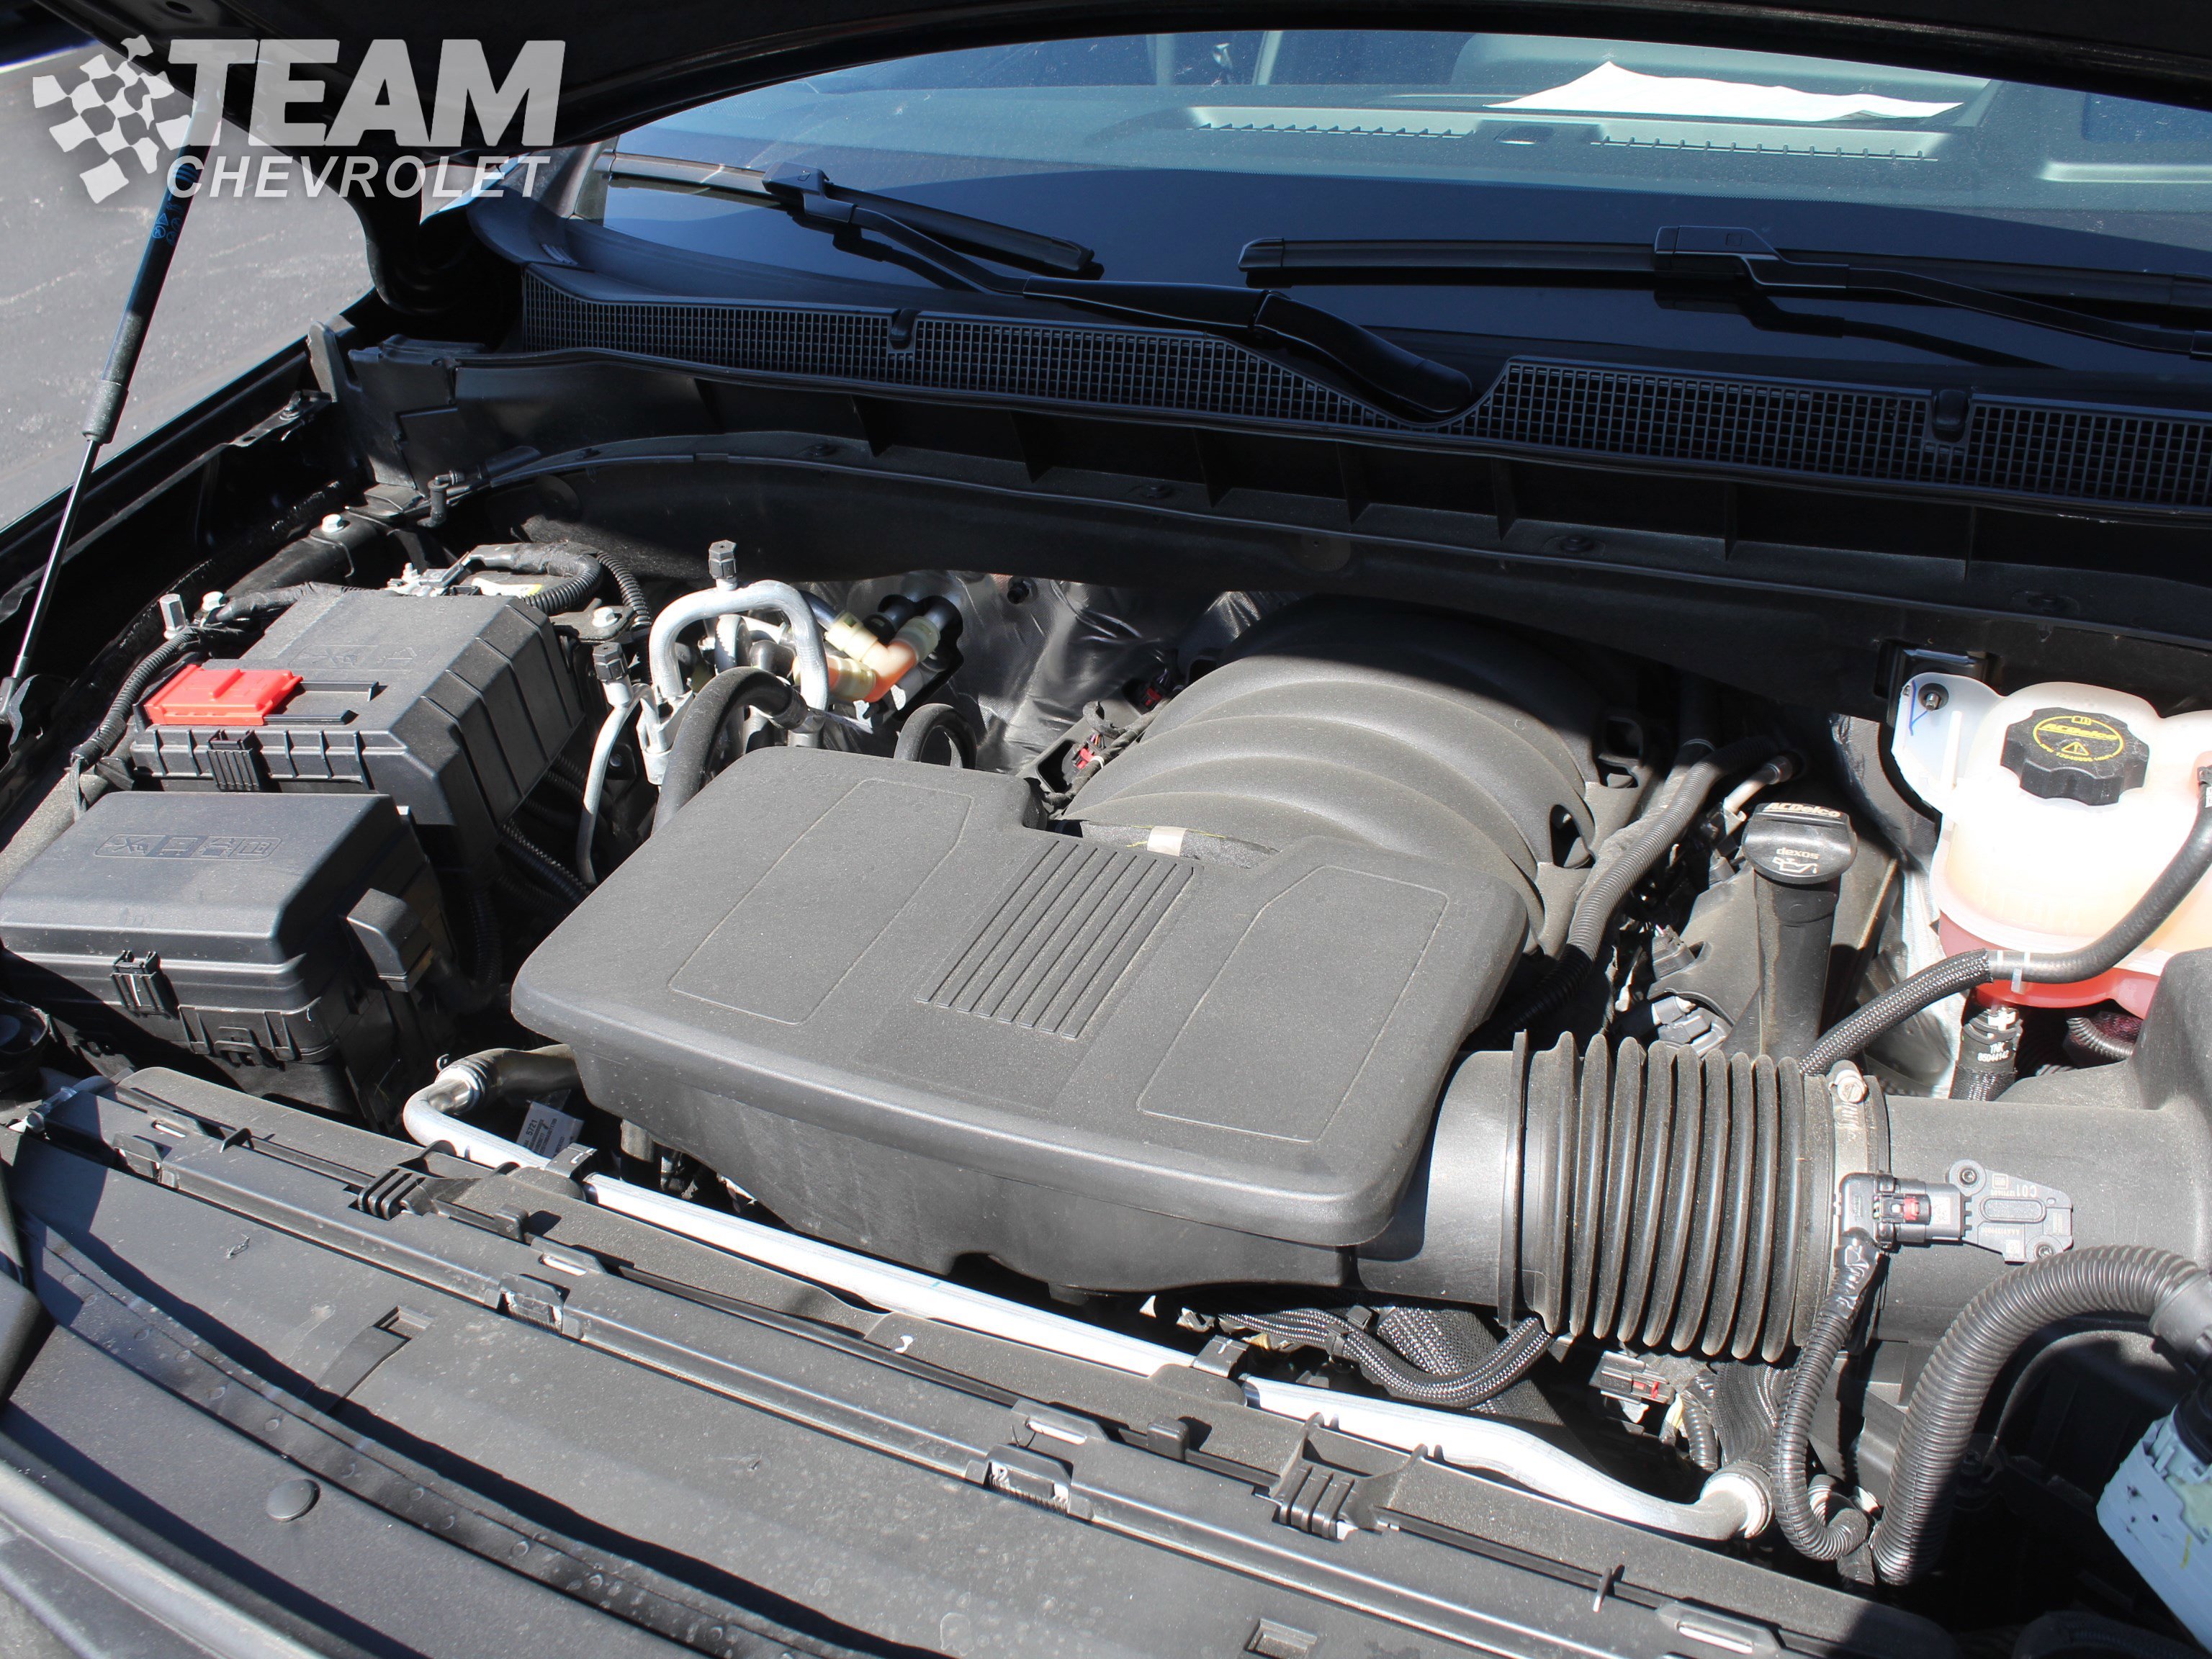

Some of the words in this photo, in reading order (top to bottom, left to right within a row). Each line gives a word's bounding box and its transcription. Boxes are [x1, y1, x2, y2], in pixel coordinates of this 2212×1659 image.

[2039, 724, 2118, 740] ACDelco
[1762, 802, 1841, 818] ACDelco
[1776, 847, 1821, 860] dexos
[526, 1119, 538, 1136] 5721
